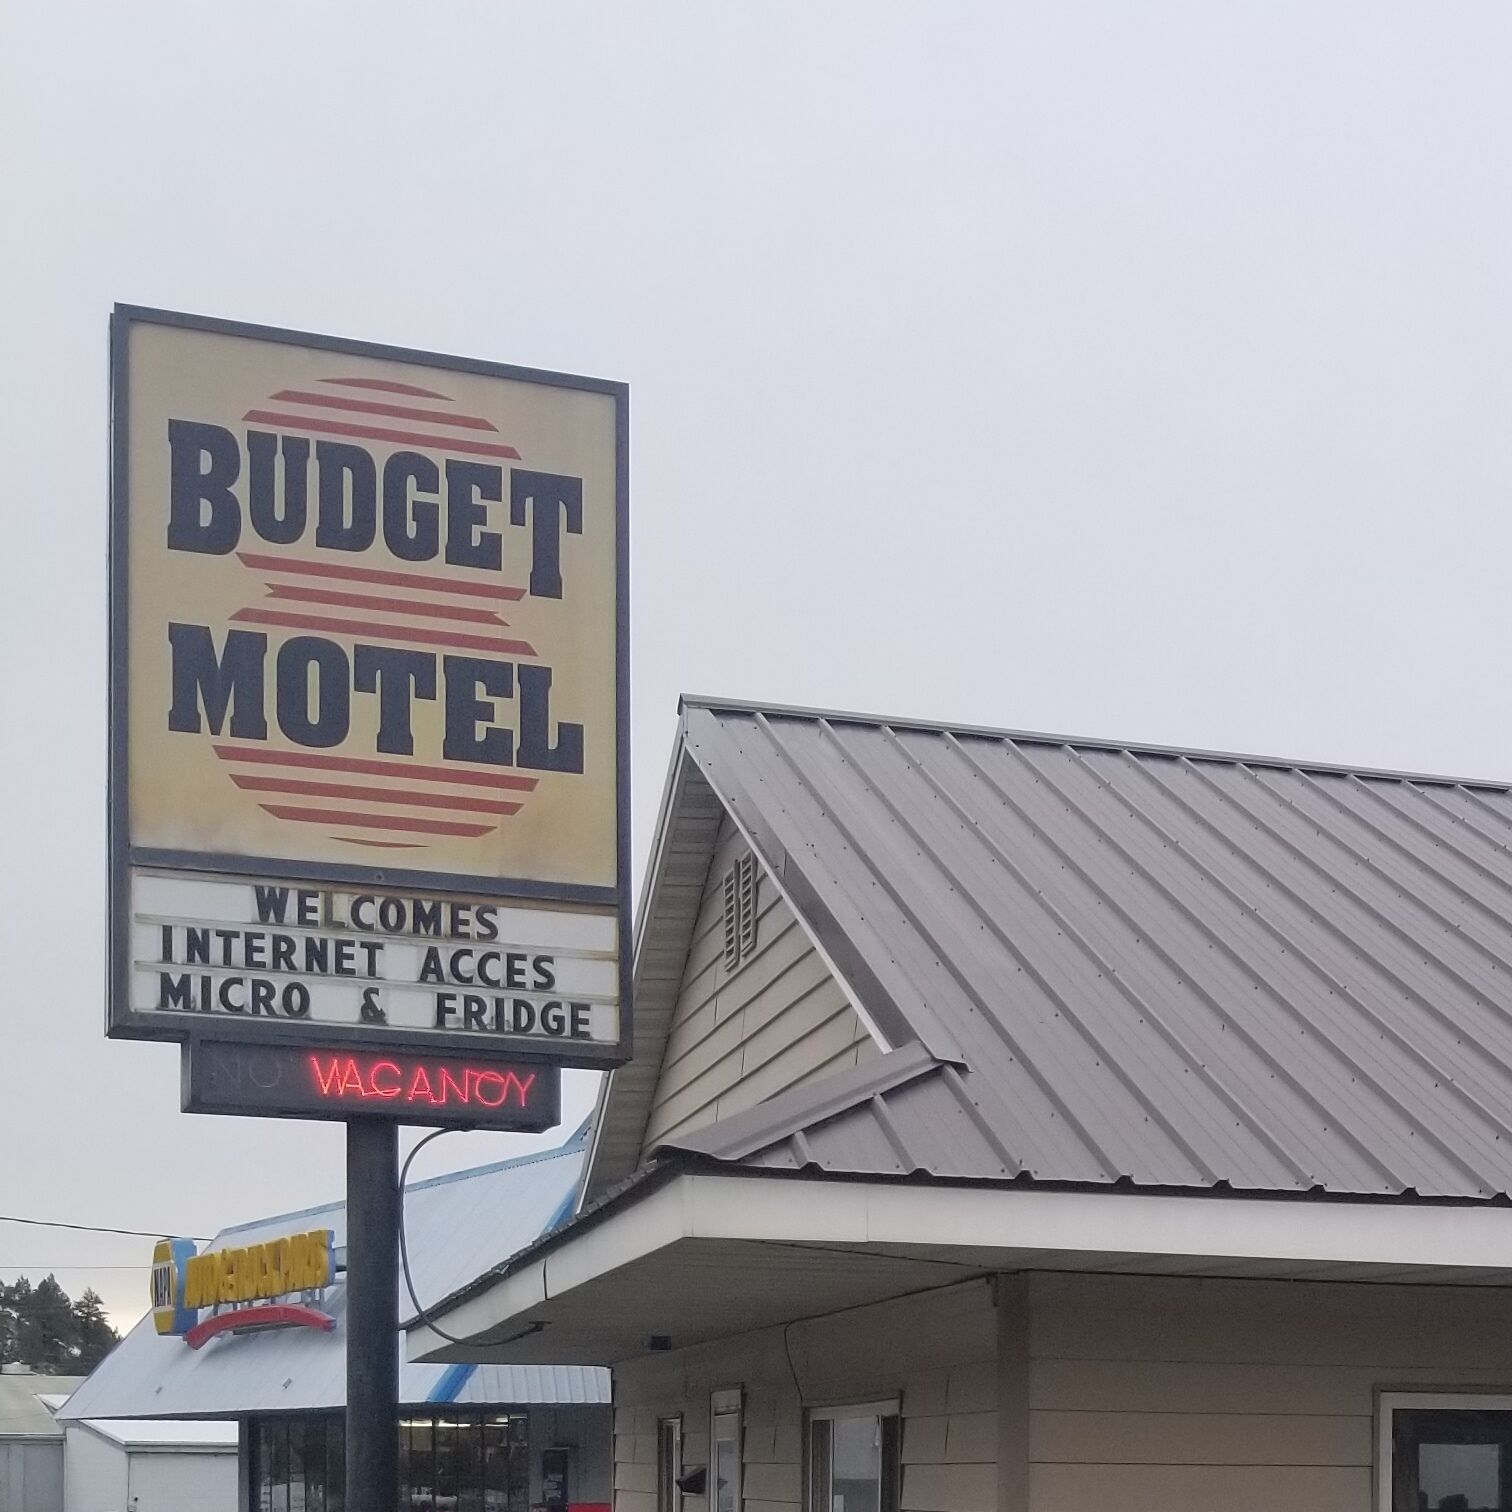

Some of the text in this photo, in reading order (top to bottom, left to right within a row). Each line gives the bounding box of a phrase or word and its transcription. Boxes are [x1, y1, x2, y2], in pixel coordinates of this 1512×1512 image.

[168, 418, 583, 600] BUDGET
[168, 622, 584, 775] MOTEL
[254, 885, 499, 941] WELCOMES
[161, 925, 557, 991] INTERNET ACCES
[158, 972, 593, 1039] MICRO & FRIDGE
[311, 1056, 536, 1107] VACANCY
